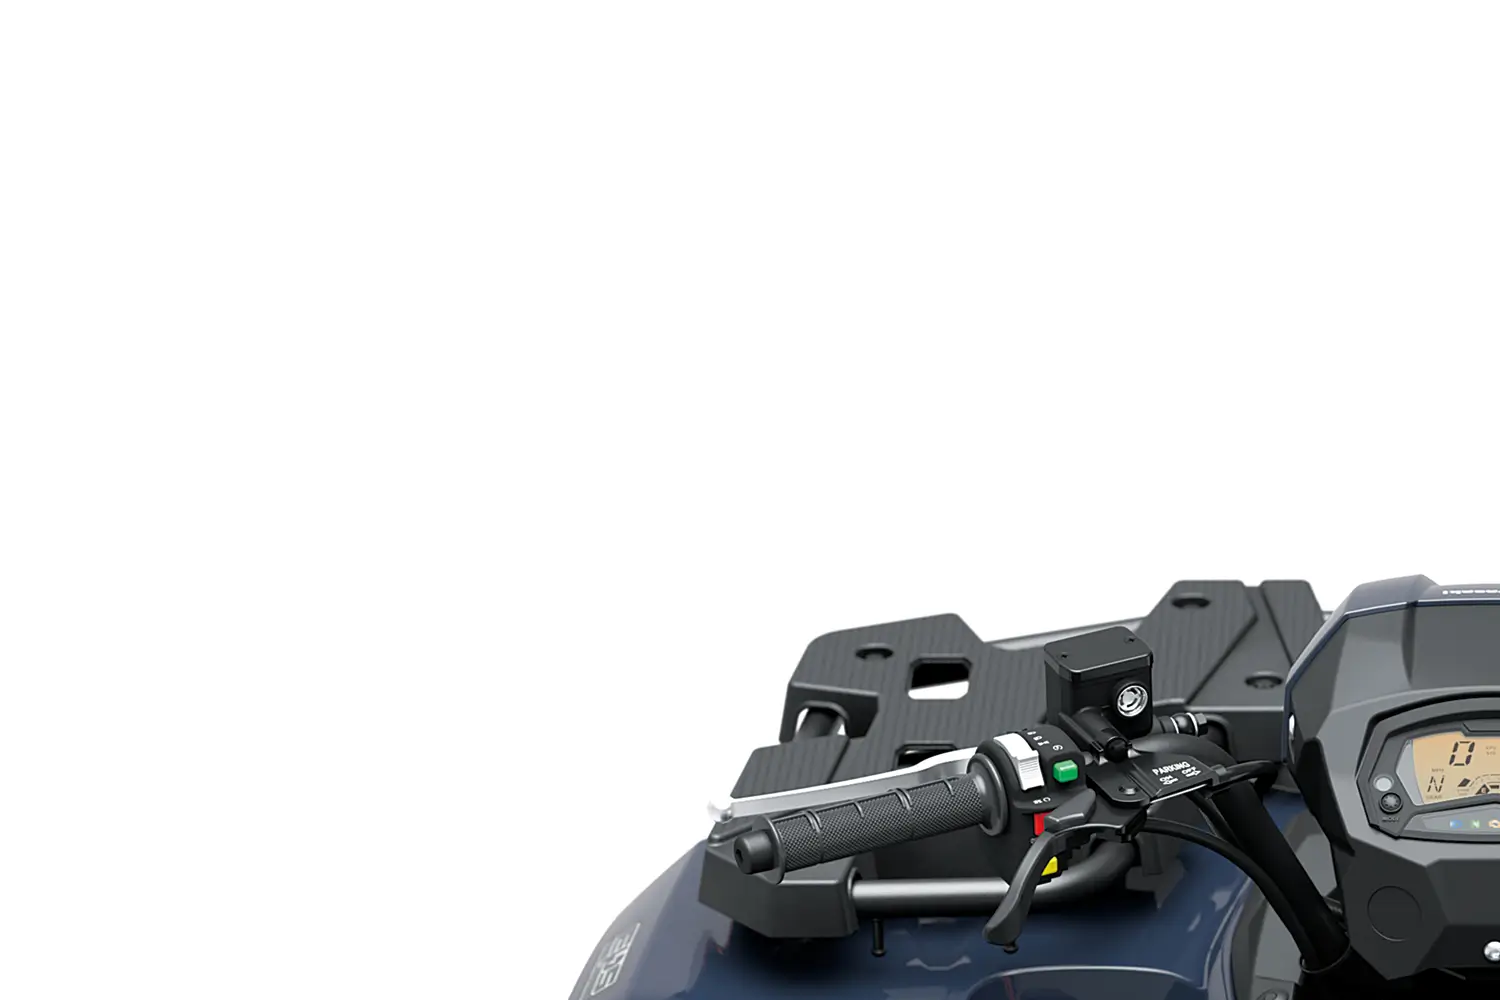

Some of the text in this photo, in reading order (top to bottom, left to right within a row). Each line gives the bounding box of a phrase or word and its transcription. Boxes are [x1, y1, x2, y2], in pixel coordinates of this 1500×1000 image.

[1449, 741, 1475, 766] 0
[1152, 761, 1190, 775] PARKING
[1427, 775, 1445, 792] N
